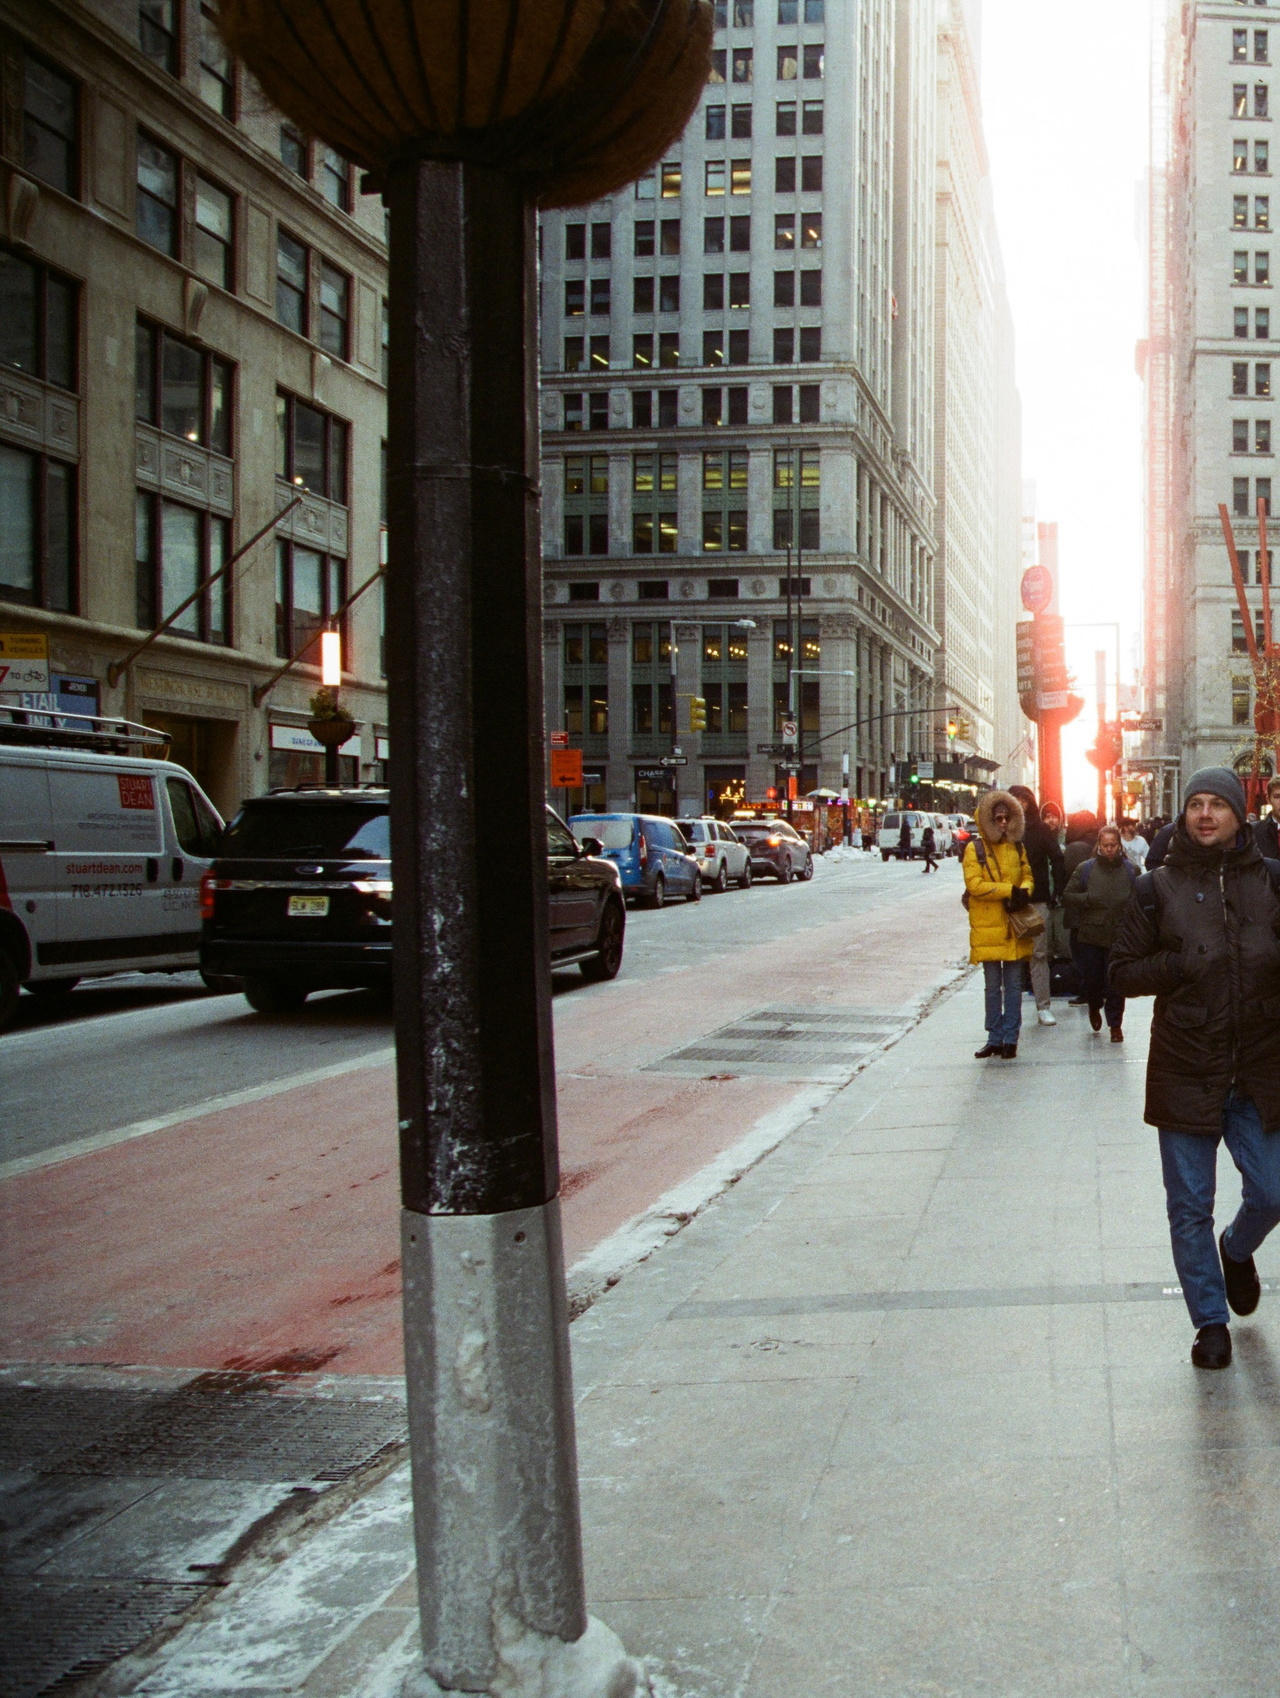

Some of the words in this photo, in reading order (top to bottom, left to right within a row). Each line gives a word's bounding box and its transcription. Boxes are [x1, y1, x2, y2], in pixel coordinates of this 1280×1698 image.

[11, 672, 21, 680] TO
[22, 692, 60, 713] ETAIL
[638, 770, 665, 778] CHASE
[120, 778, 151, 790] STUART
[121, 791, 153, 805] DEAN
[66, 863, 143, 874] stuartdean.com
